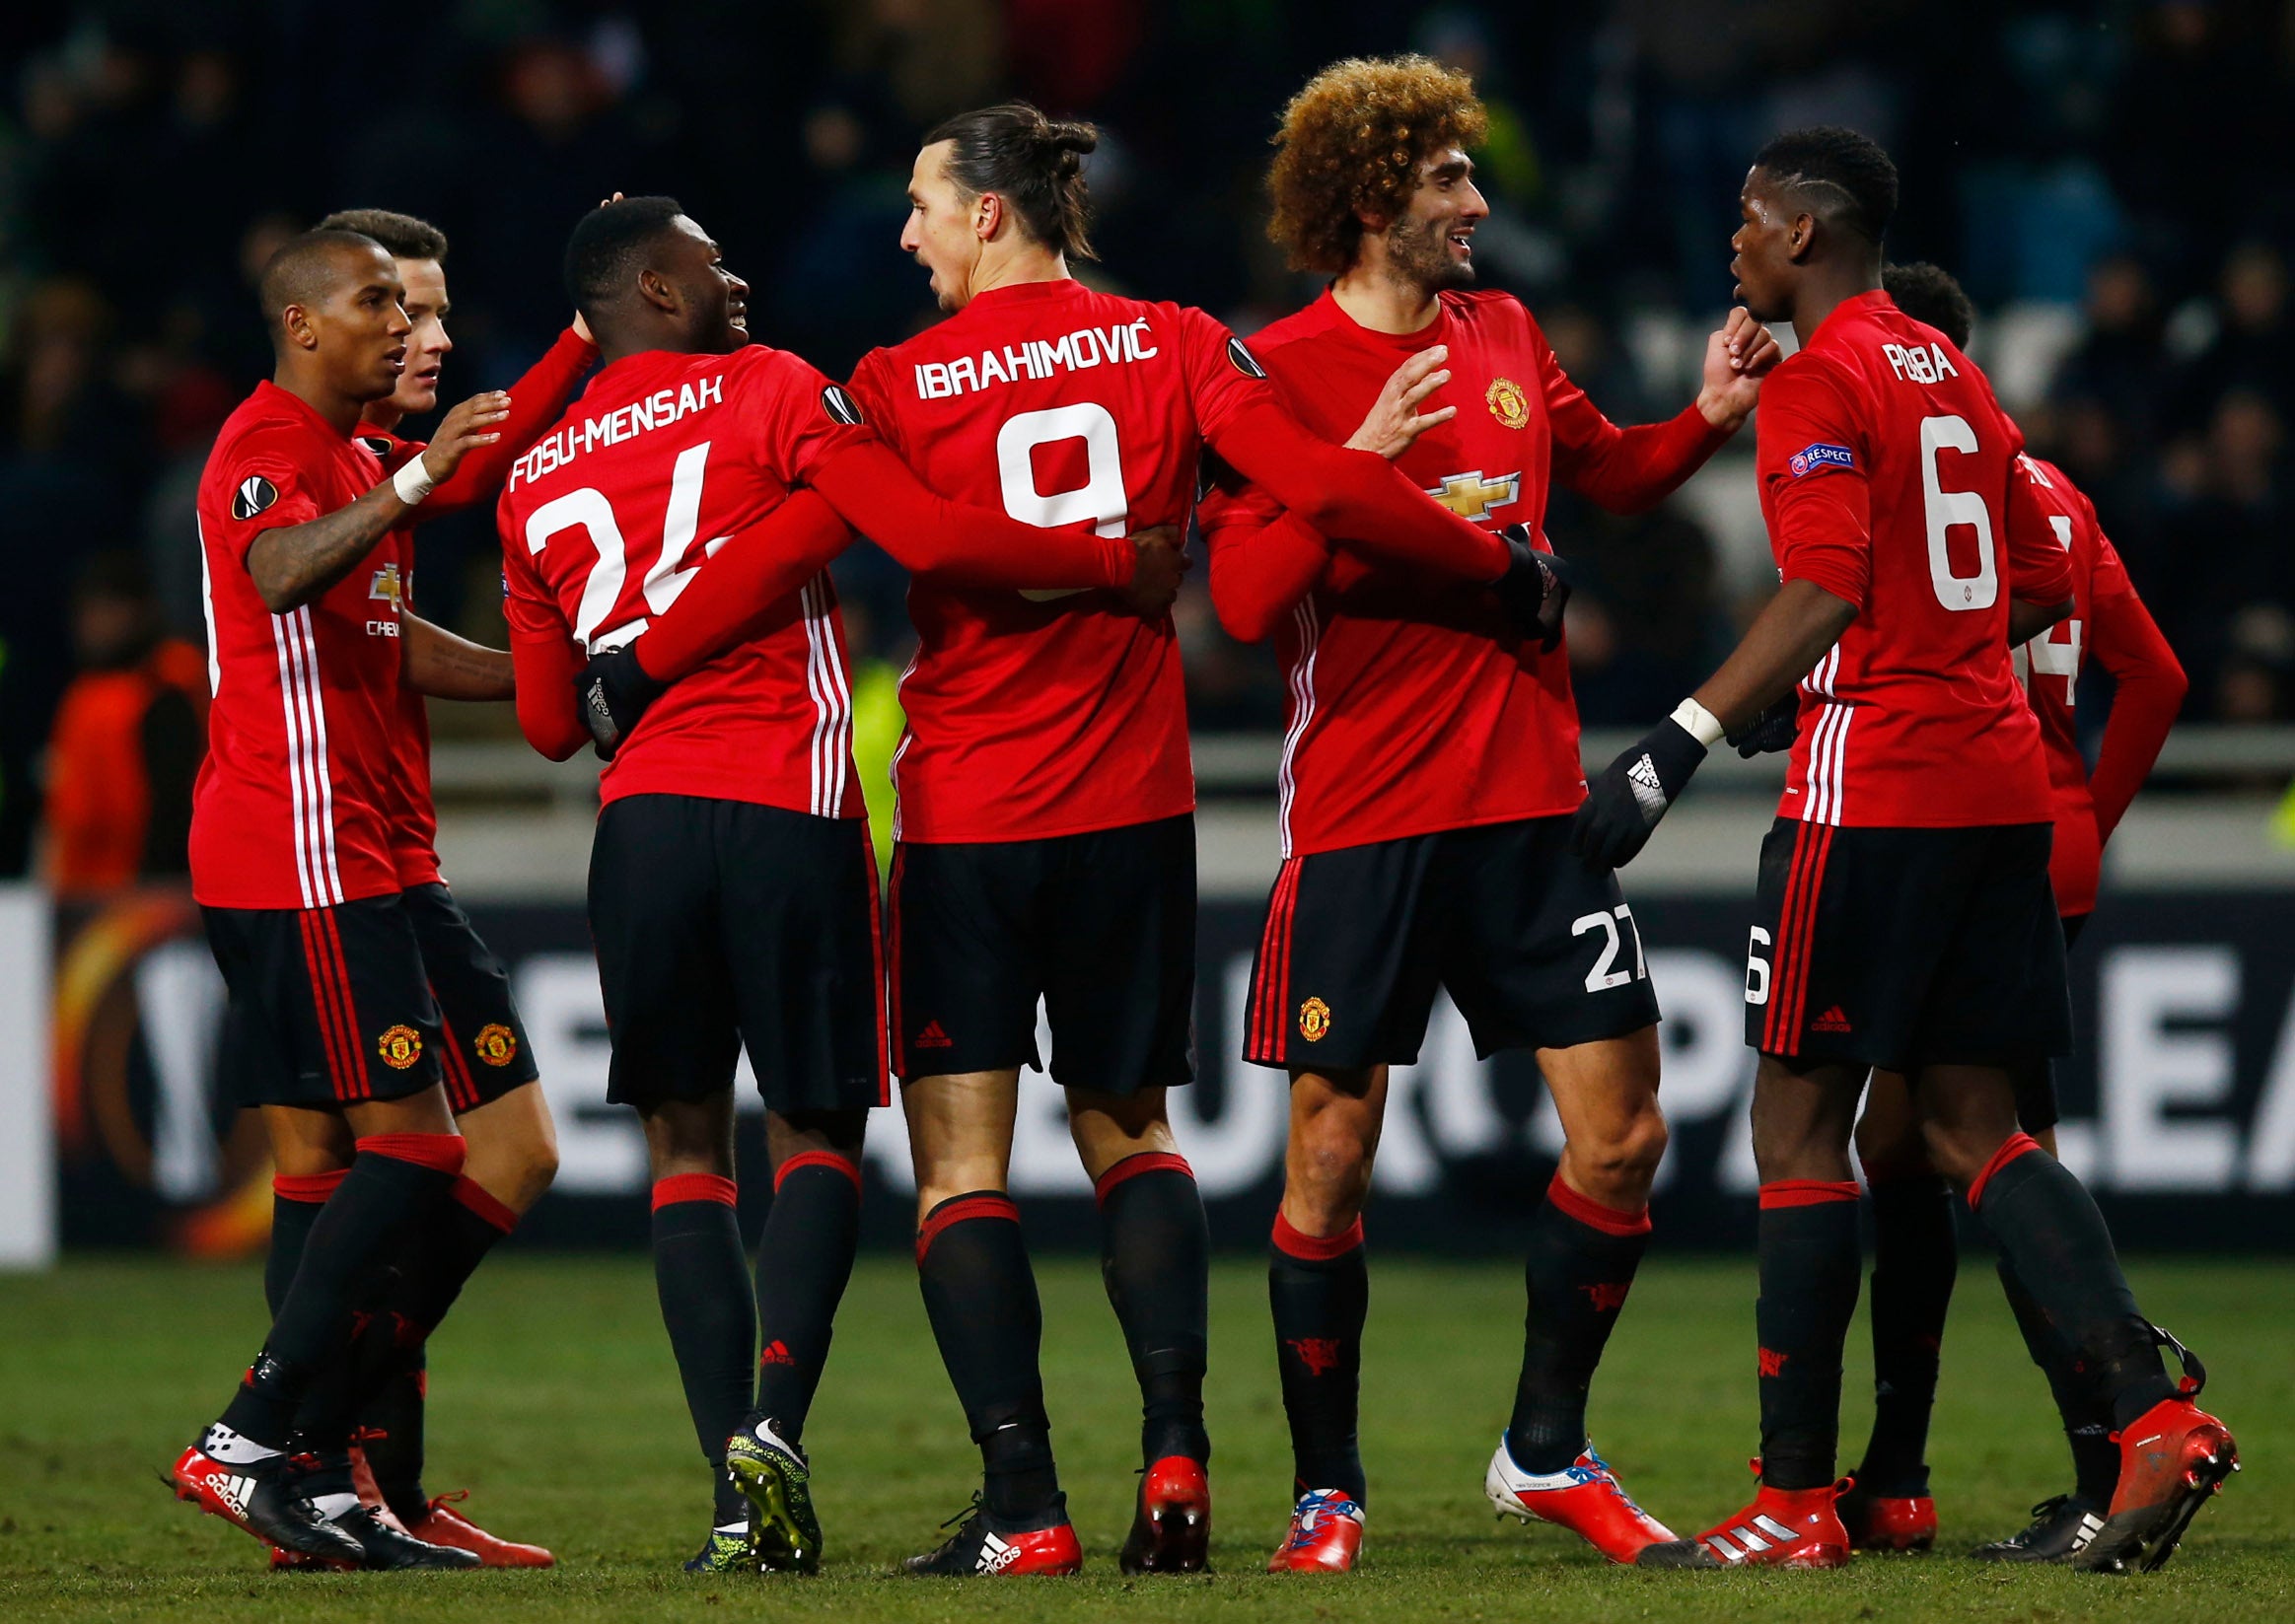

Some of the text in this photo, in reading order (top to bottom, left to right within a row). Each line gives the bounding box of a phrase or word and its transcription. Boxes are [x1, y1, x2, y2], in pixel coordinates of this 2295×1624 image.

[914, 317, 1158, 399] IBRAHIMOVIĆ
[509, 375, 723, 493] FOSU-MENSAH
[1807, 448, 1852, 463] RESPECT
[997, 402, 1127, 602] 9
[1920, 415, 1997, 611] 6
[526, 441, 734, 661] 24
[1641, 752, 1661, 788] adidas
[1571, 903, 1646, 993] 27
[1745, 925, 1771, 1005] 6
[1812, 1023, 1852, 1032] adidas
[205, 1473, 250, 1521] adidas
[979, 1545, 1022, 1577] didas
